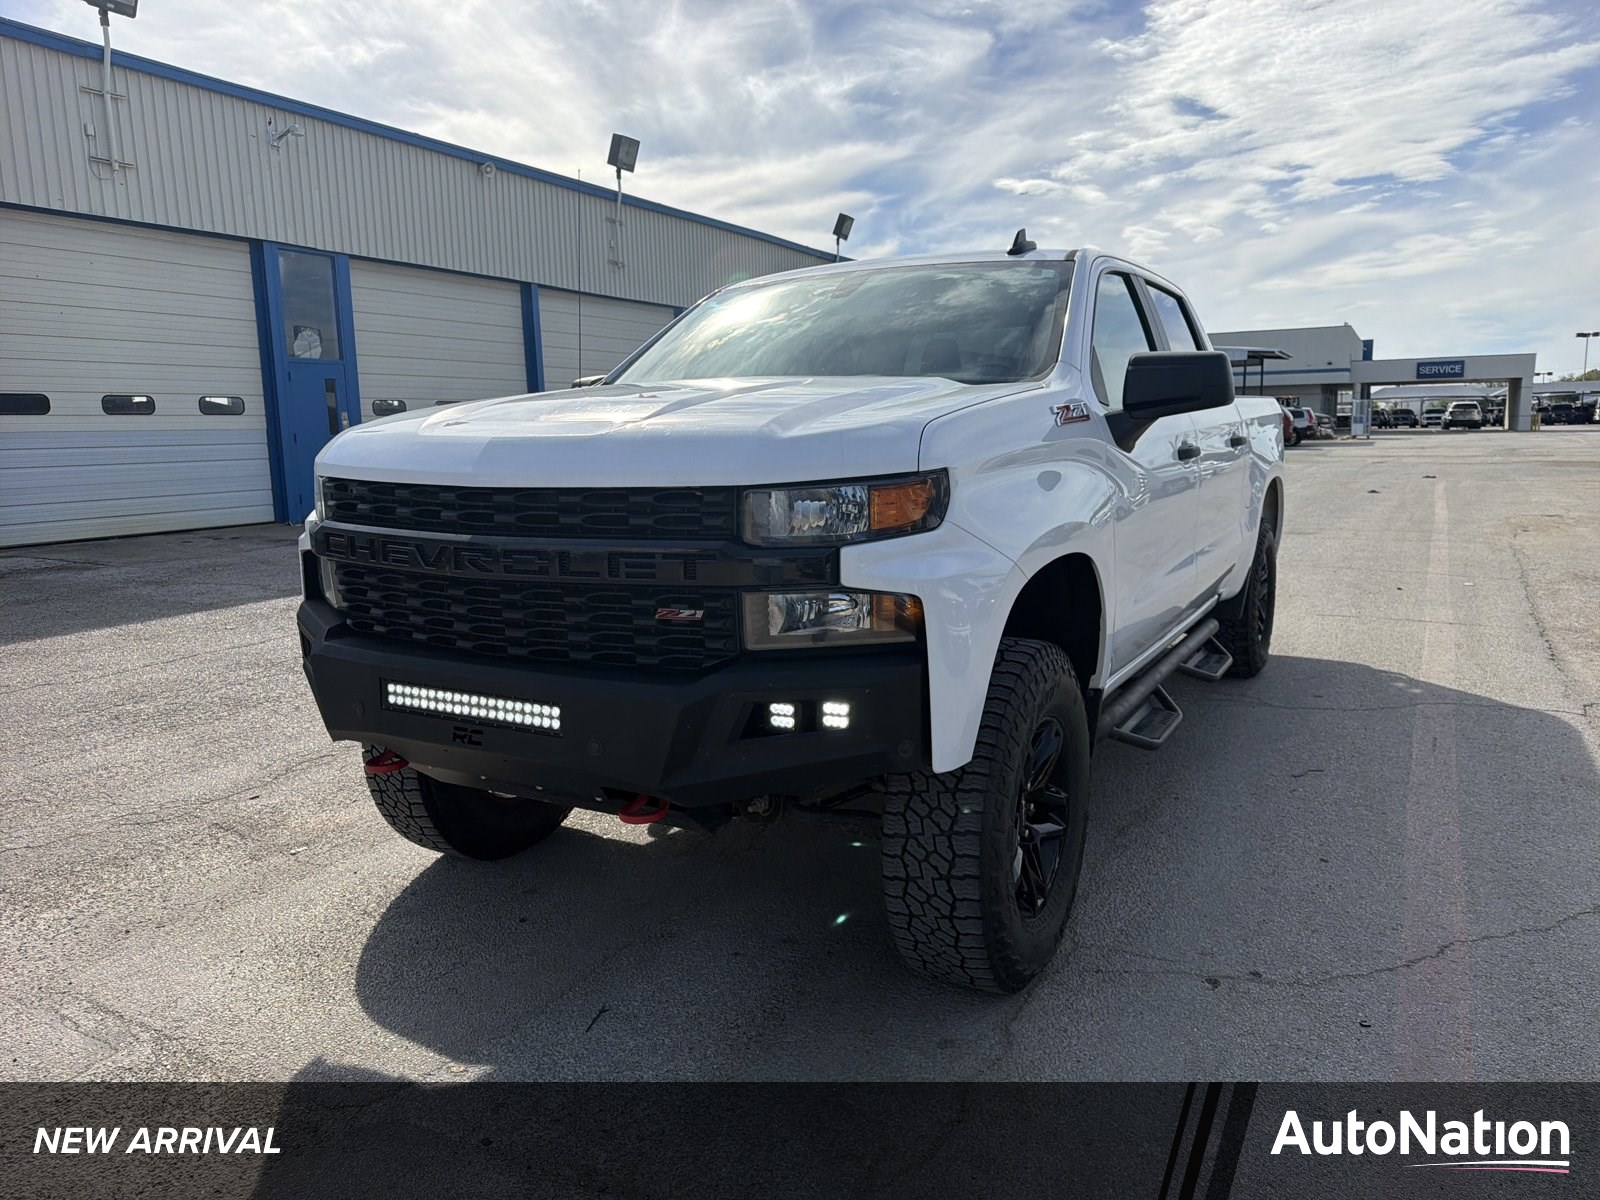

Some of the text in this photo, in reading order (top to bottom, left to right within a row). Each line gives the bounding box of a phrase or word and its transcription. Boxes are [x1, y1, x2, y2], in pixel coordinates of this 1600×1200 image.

[1419, 364, 1462, 375] SERVICE
[325, 532, 717, 581] CHEVROLET
[453, 726, 483, 746] RC
